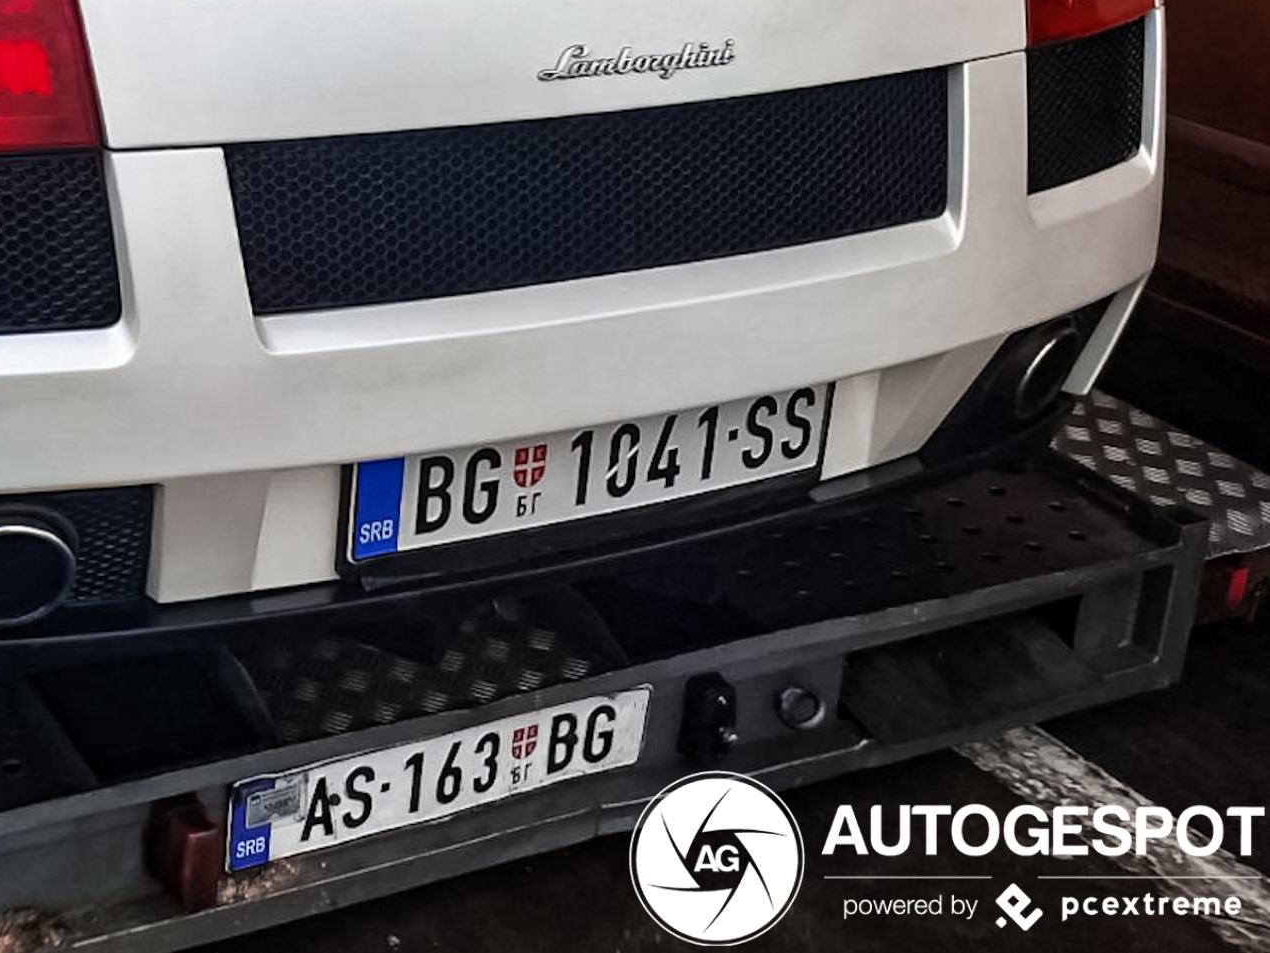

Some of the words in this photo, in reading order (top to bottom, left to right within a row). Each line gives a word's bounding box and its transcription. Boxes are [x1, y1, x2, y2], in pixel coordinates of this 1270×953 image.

[537, 39, 735, 81] Lamborghini
[415, 448, 501, 535] BG
[359, 519, 394, 544] SRB
[547, 704, 615, 775] BG
[236, 836, 266, 858] SRB
